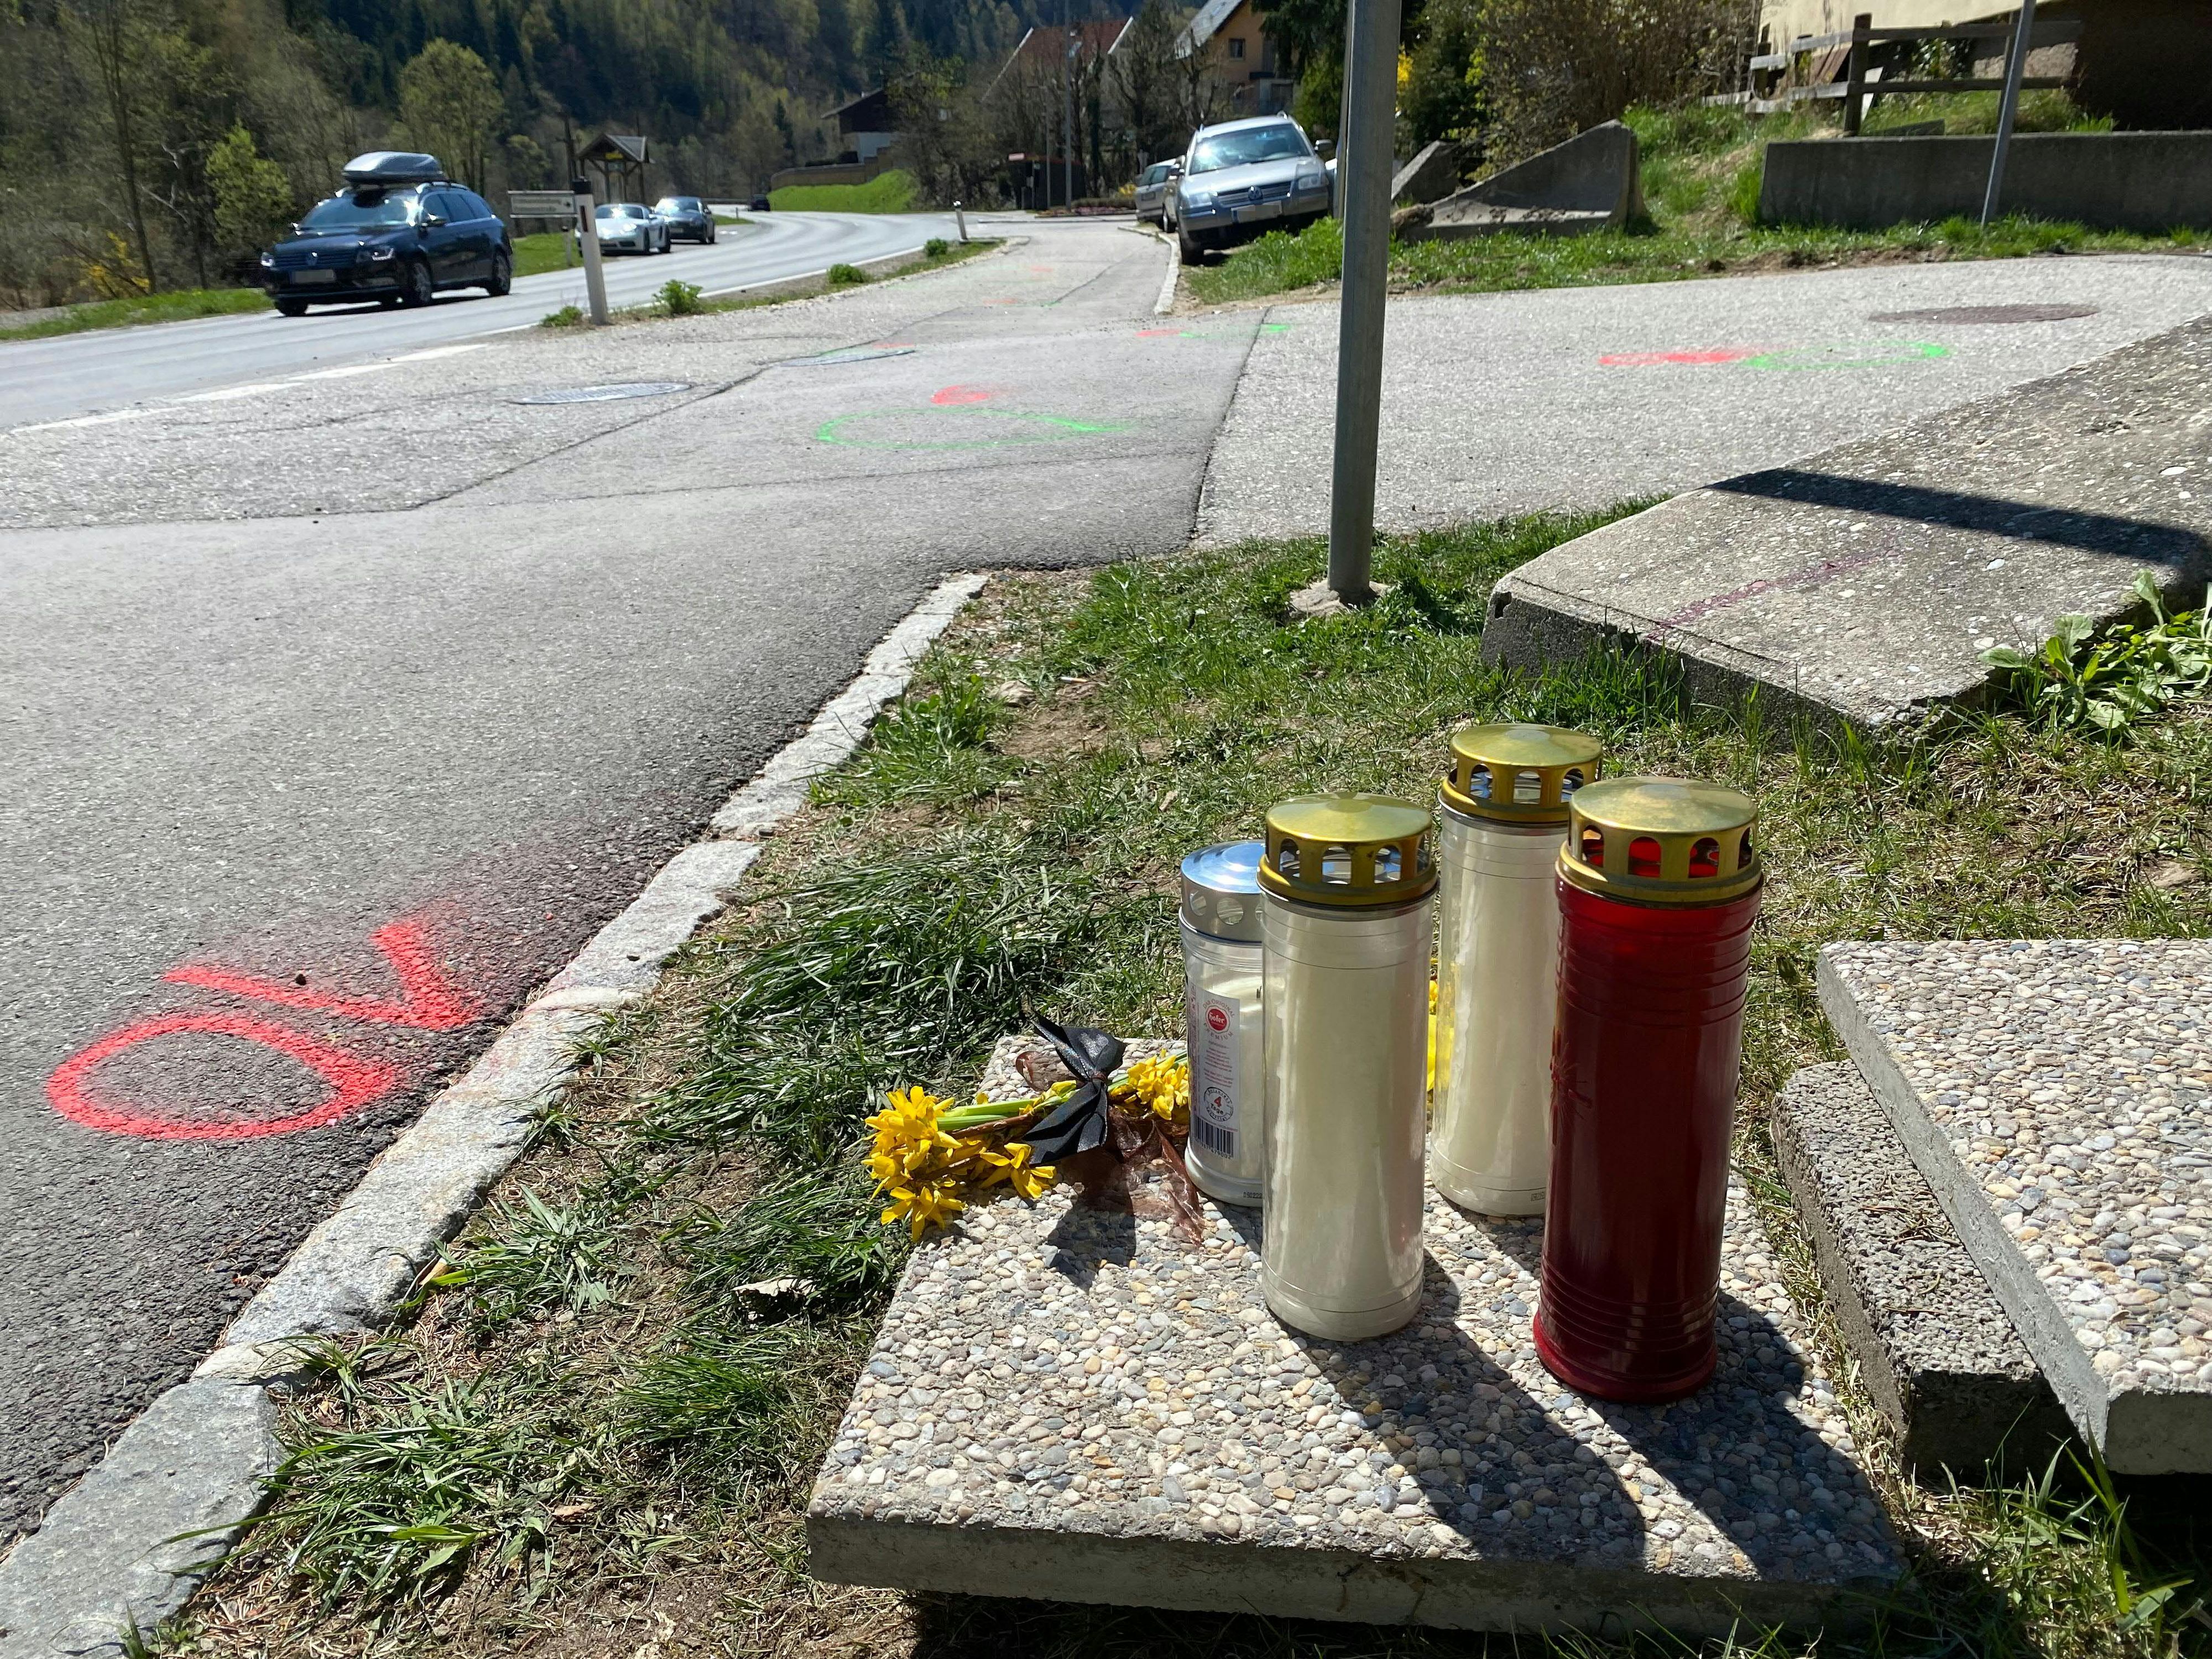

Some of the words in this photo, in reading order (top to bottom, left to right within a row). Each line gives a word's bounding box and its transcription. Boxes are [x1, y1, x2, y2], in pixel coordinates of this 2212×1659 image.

[1211, 999, 1235, 1018] ORIGINAL
[1203, 1022, 1234, 1040] PREMIUM
[1211, 1103, 1224, 1115] Tage
[1214, 1096, 1222, 1108] 4
